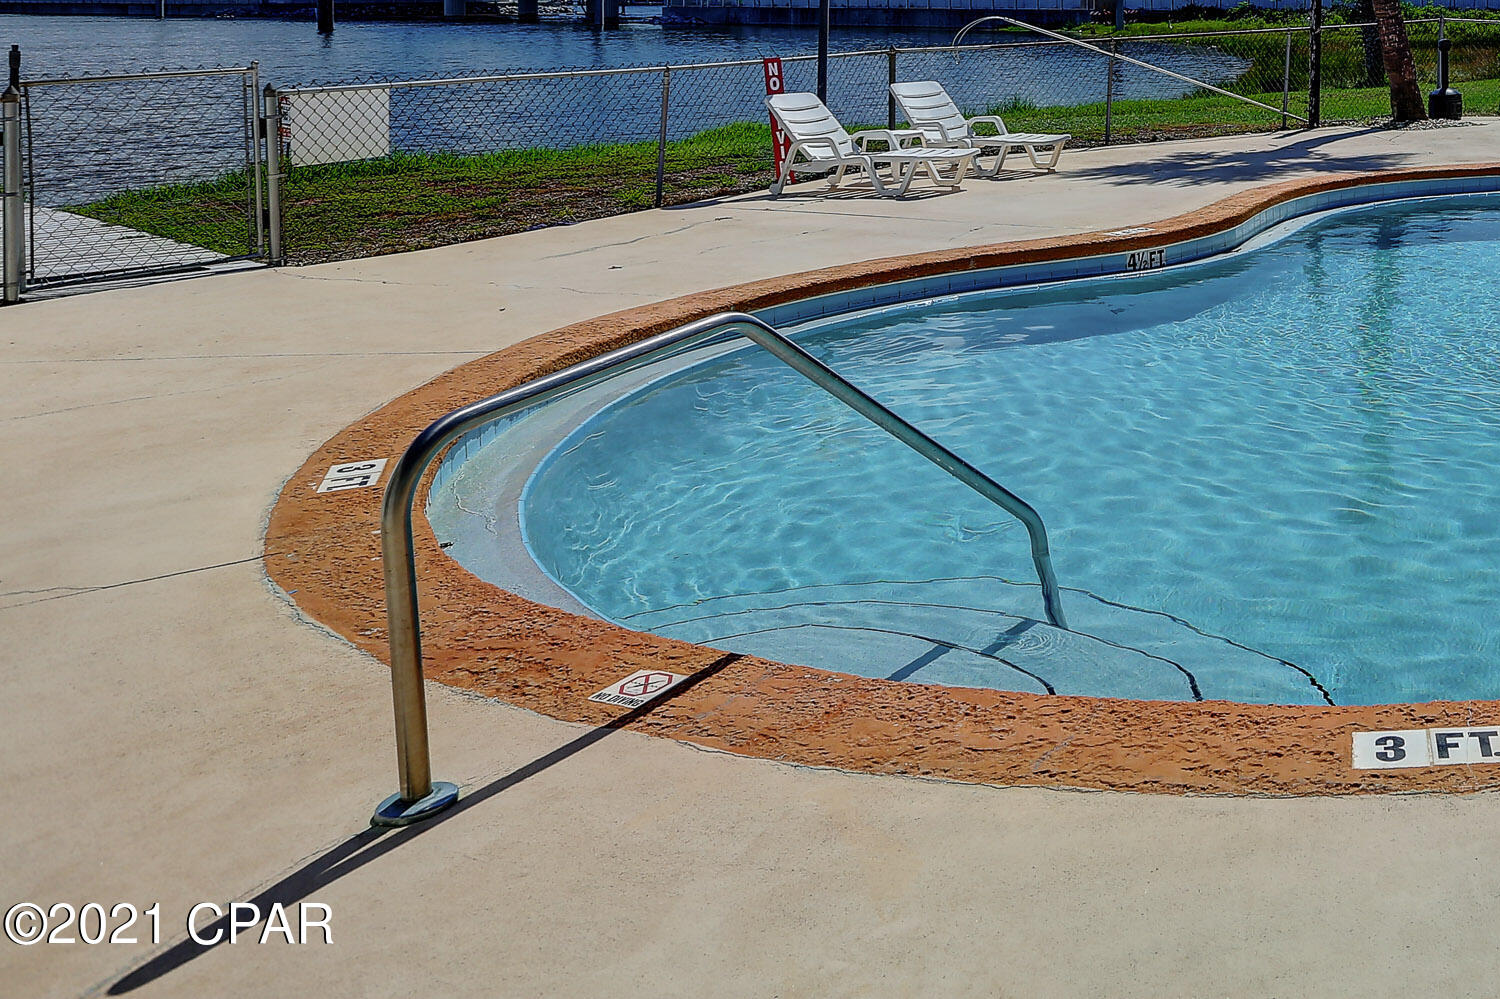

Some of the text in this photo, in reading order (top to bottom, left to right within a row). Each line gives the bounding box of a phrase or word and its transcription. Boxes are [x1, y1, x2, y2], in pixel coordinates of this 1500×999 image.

[767, 62, 780, 91] NO
[336, 463, 377, 473] 3
[591, 691, 644, 706] NO DIVING
[1375, 735, 1406, 762] 3
